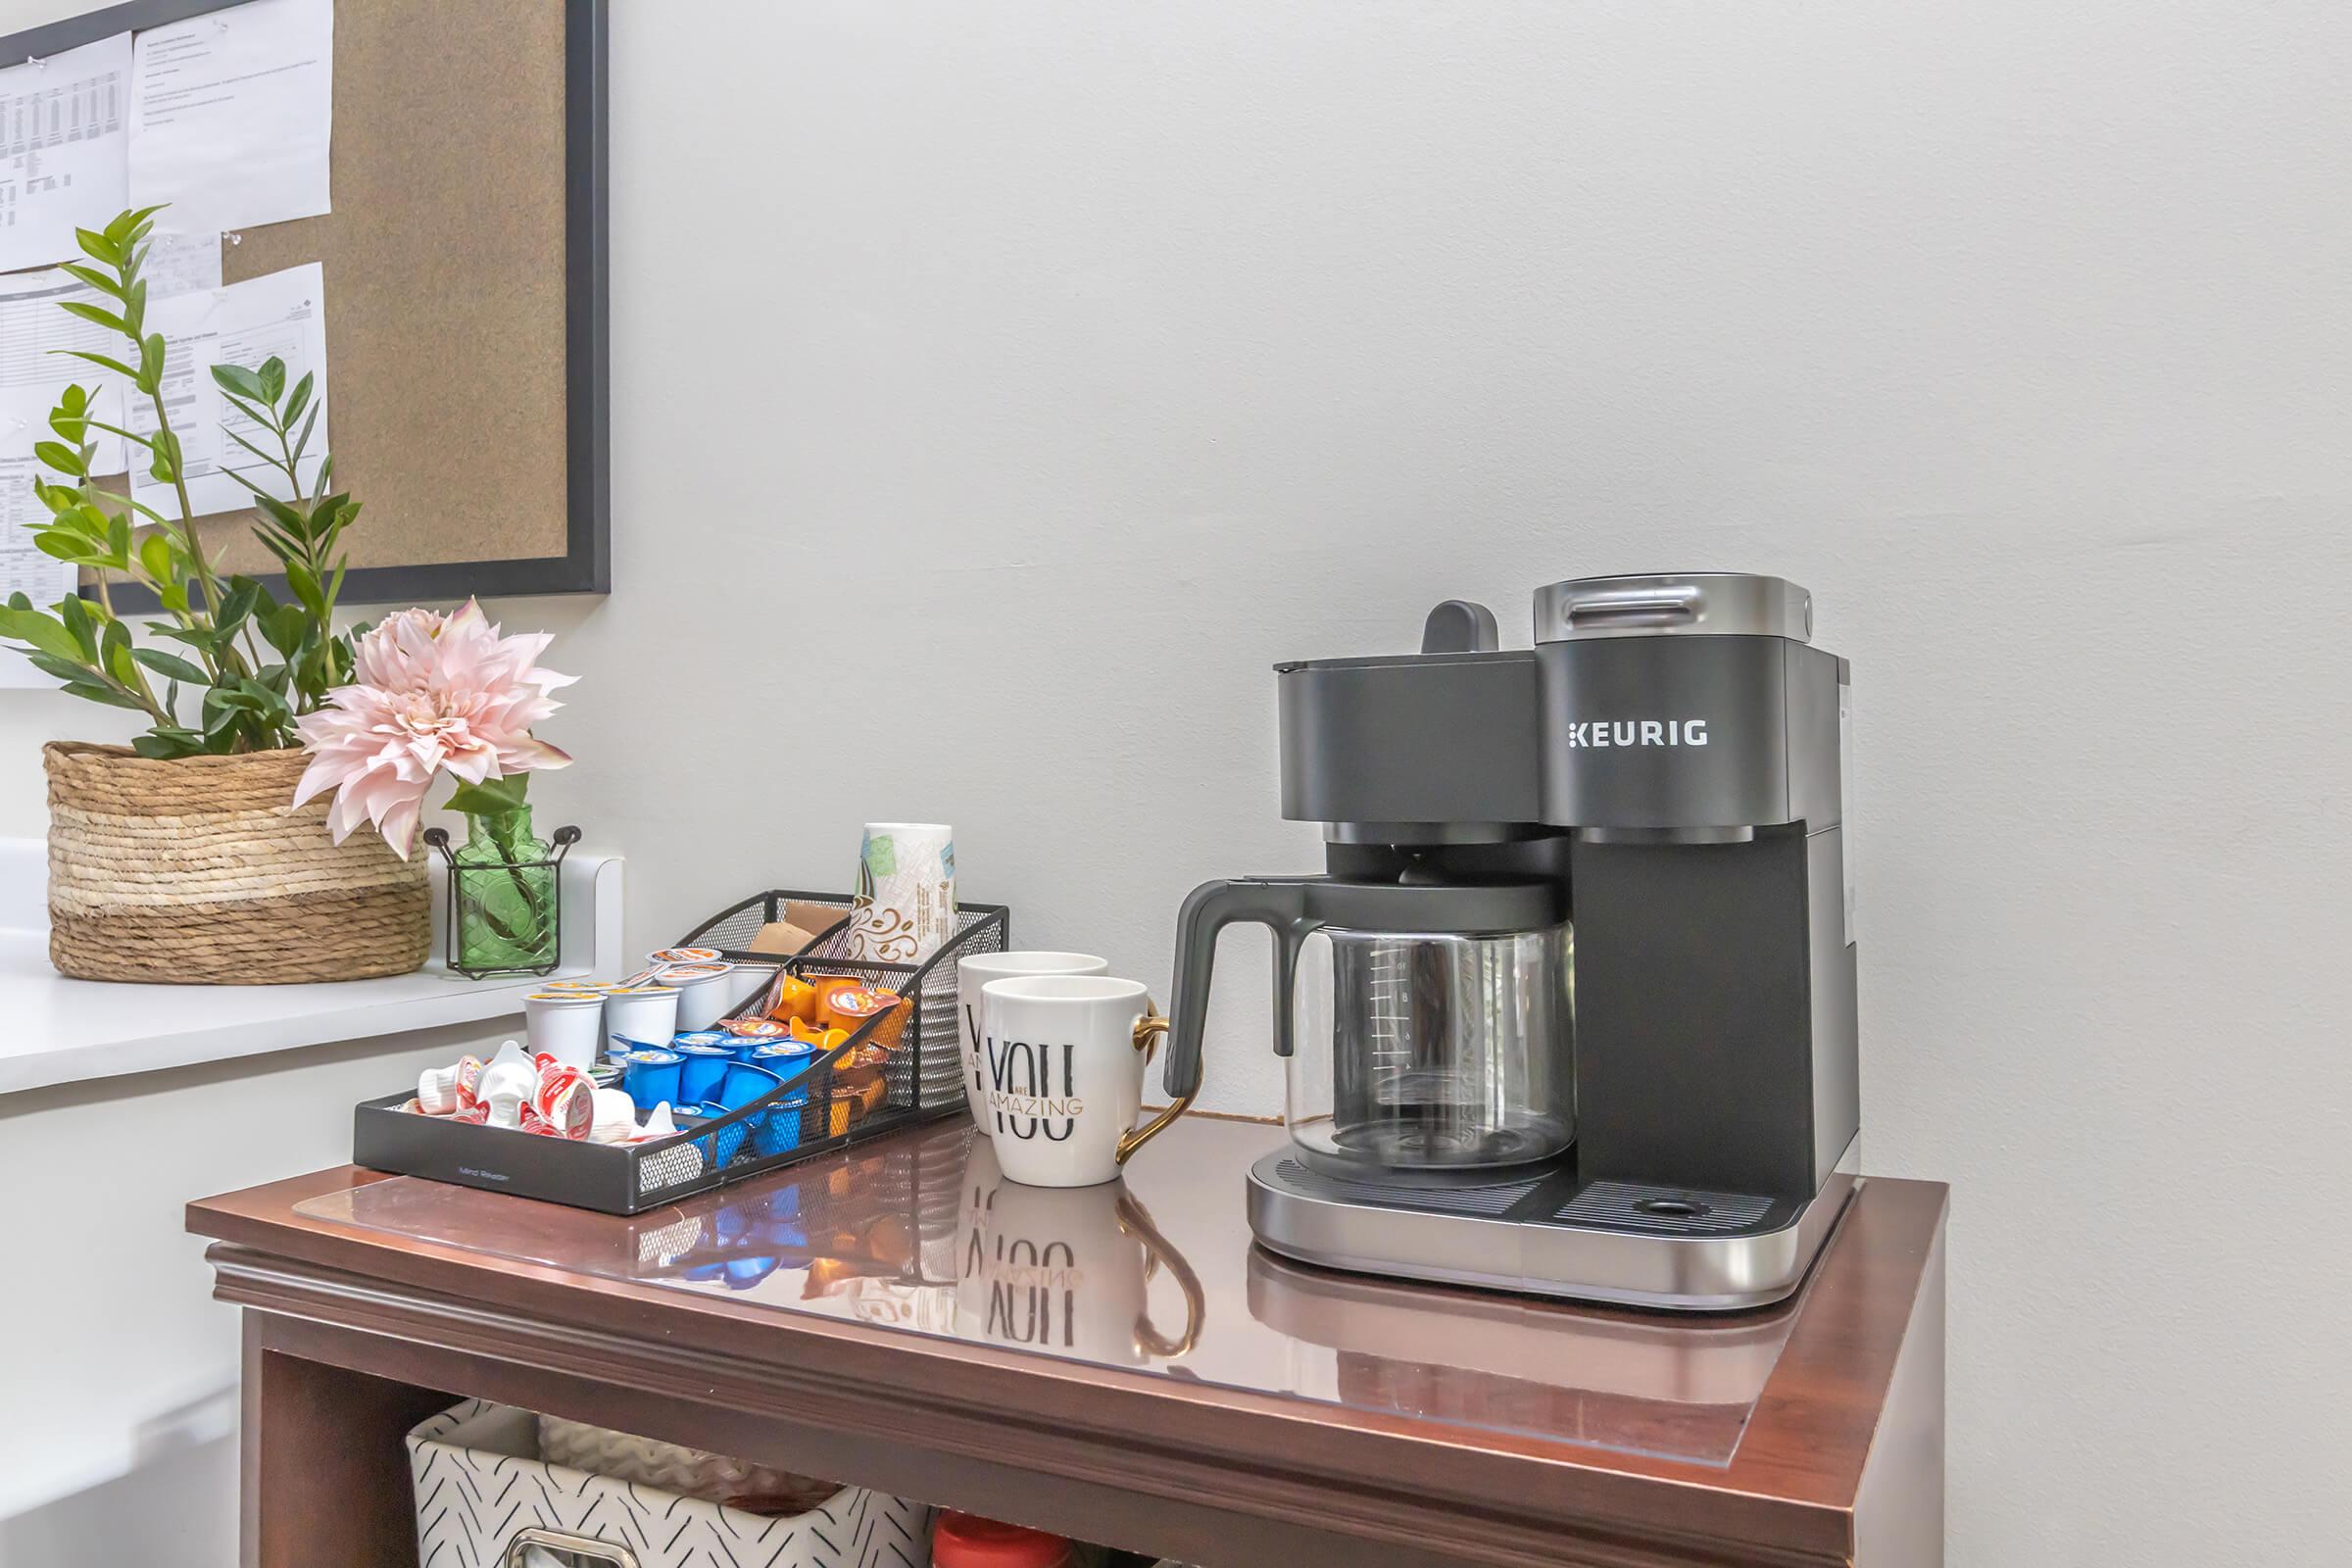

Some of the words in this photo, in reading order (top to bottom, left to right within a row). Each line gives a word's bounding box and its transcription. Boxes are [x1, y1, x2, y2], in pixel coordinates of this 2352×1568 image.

[1569, 719, 1708, 748] KEURIG
[987, 1037, 1075, 1142] YOU
[1012, 1085, 1028, 1097] ARE
[989, 1091, 1084, 1116] AMAZING
